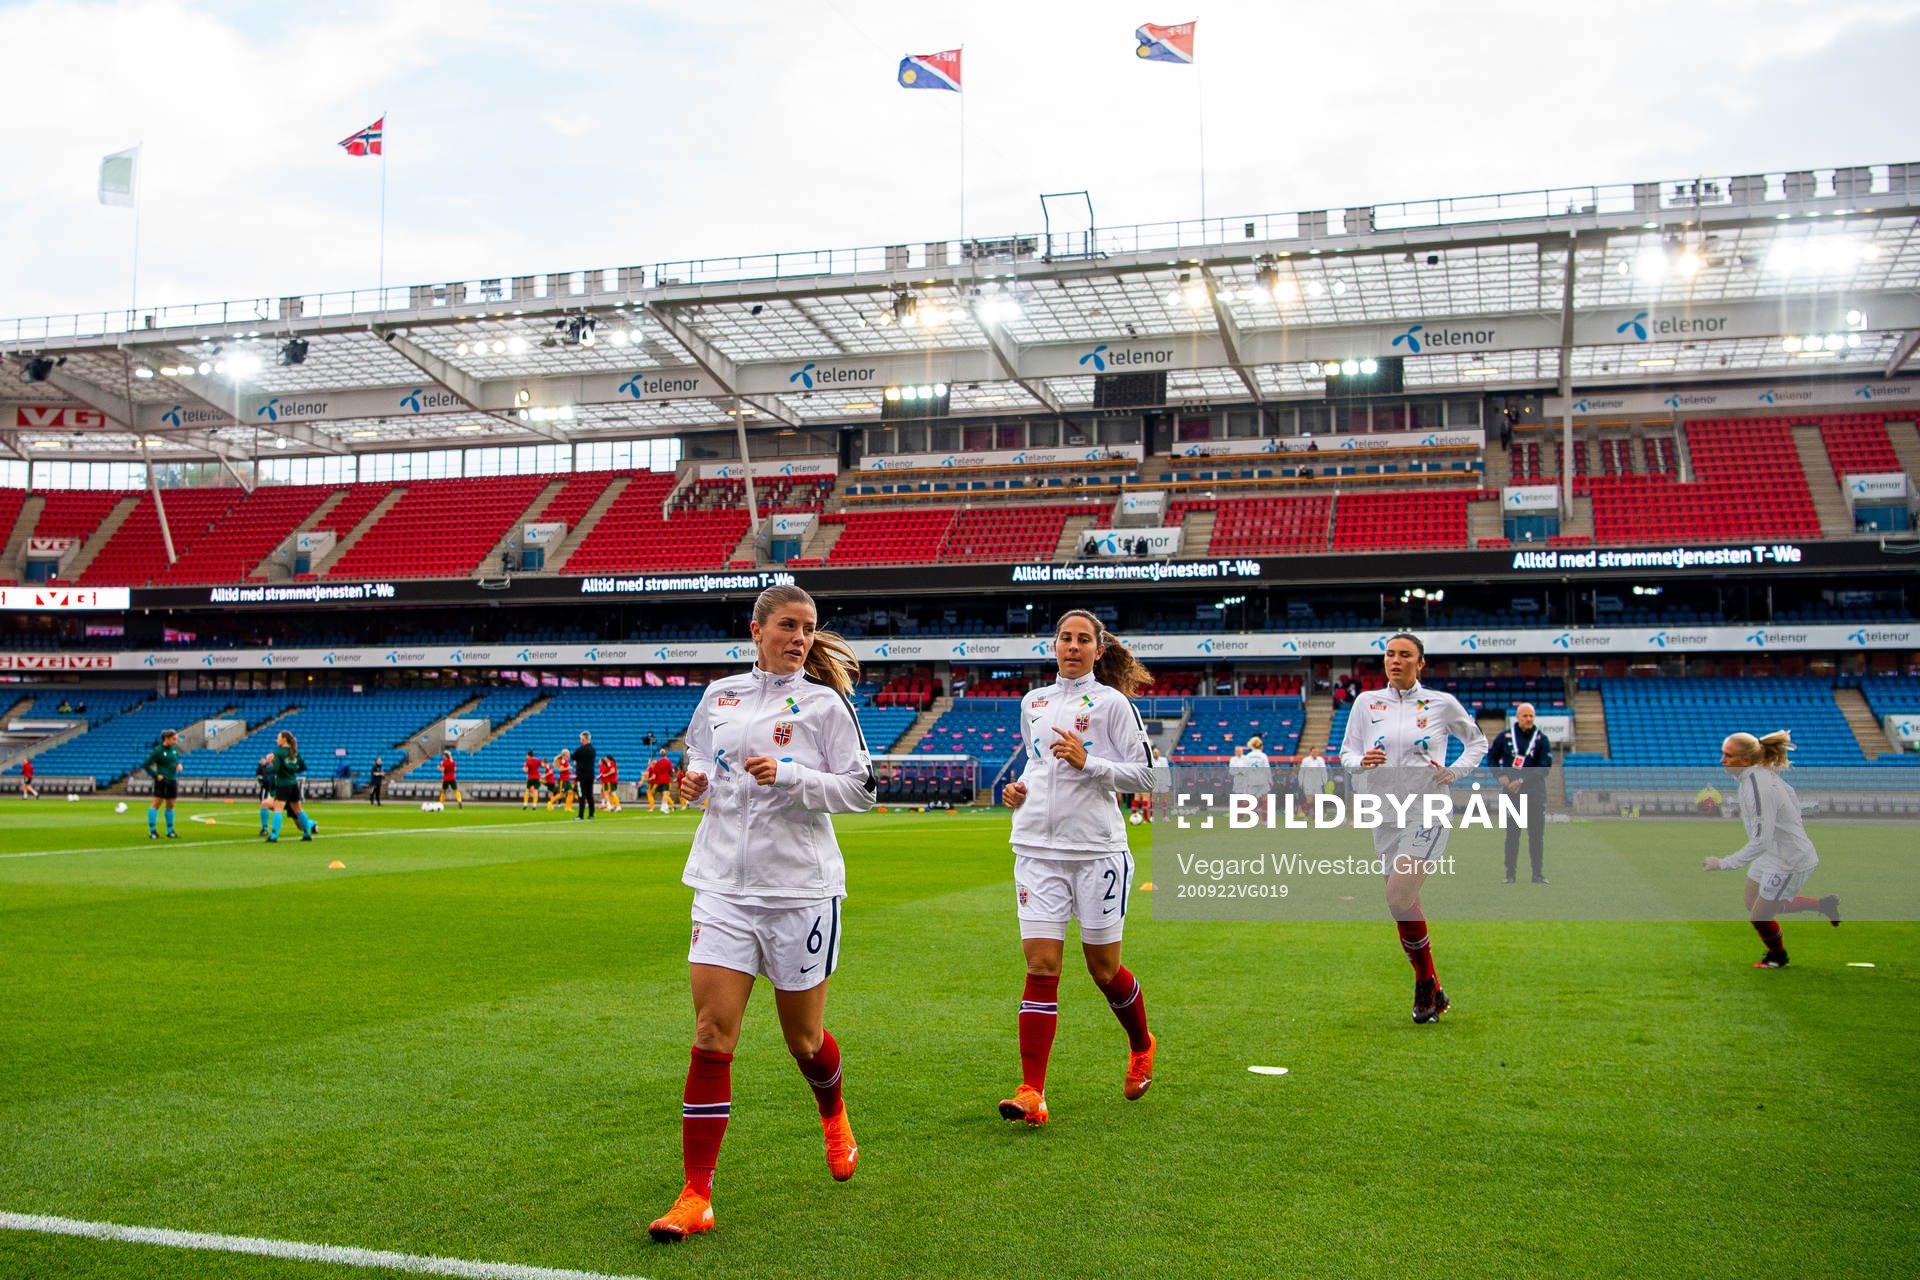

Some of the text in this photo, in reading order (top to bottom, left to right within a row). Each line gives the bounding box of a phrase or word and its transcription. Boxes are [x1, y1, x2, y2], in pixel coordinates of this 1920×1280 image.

[1653, 315, 1727, 334] telenor
[1424, 328, 1495, 347] telenor
[1109, 348, 1174, 366] telenor
[816, 366, 875, 383] telenor
[644, 378, 699, 394] telenor
[280, 401, 328, 416] telenor
[18, 406, 105, 428] VG
[1512, 545, 1802, 569] Alltid med strømmetjenesten T-We
[1012, 566, 1050, 581] Alltid
[1218, 560, 1261, 577] T-We
[581, 573, 796, 593] Alltid med strømmetjenesten T-We
[210, 586, 239, 602] Alltid
[240, 586, 264, 601] med
[363, 583, 395, 598] T-We
[1477, 636, 1517, 648] telenor
[1570, 635, 1611, 647] telenor
[1666, 634, 1708, 645] telenor
[1764, 632, 1808, 644] telenor
[1866, 630, 1911, 643] telenor
[888, 644, 922, 656] telenor
[966, 643, 1000, 655] telenor
[1212, 639, 1249, 651] telenor
[1298, 637, 1336, 650] telenor
[462, 651, 490, 661] telenor
[529, 650, 558, 661] telenor
[597, 649, 627, 660] telenor
[667, 648, 698, 659] telenor
[719, 698, 739, 706] TINE
[1103, 869, 1117, 900] 2
[806, 915, 823, 954] 6
